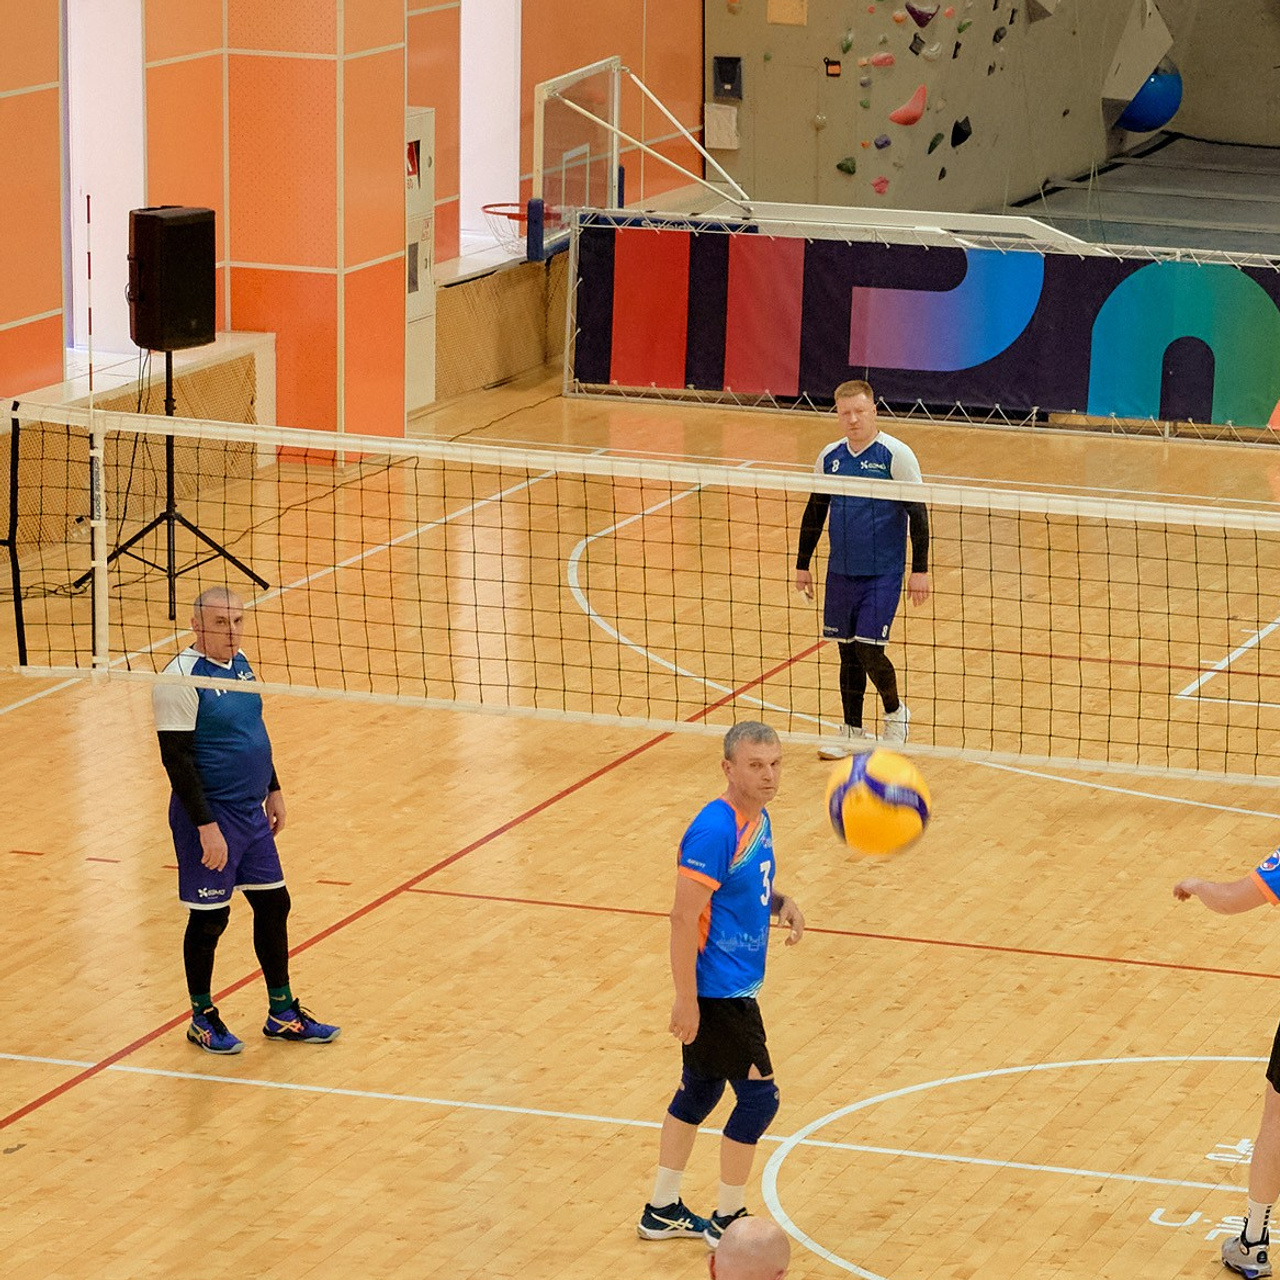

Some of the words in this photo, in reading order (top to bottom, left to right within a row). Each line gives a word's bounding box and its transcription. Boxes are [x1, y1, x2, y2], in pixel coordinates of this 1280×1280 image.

[832, 459, 840, 473] 8
[882, 625, 888, 638] 8
[760, 860, 771, 906] 3
